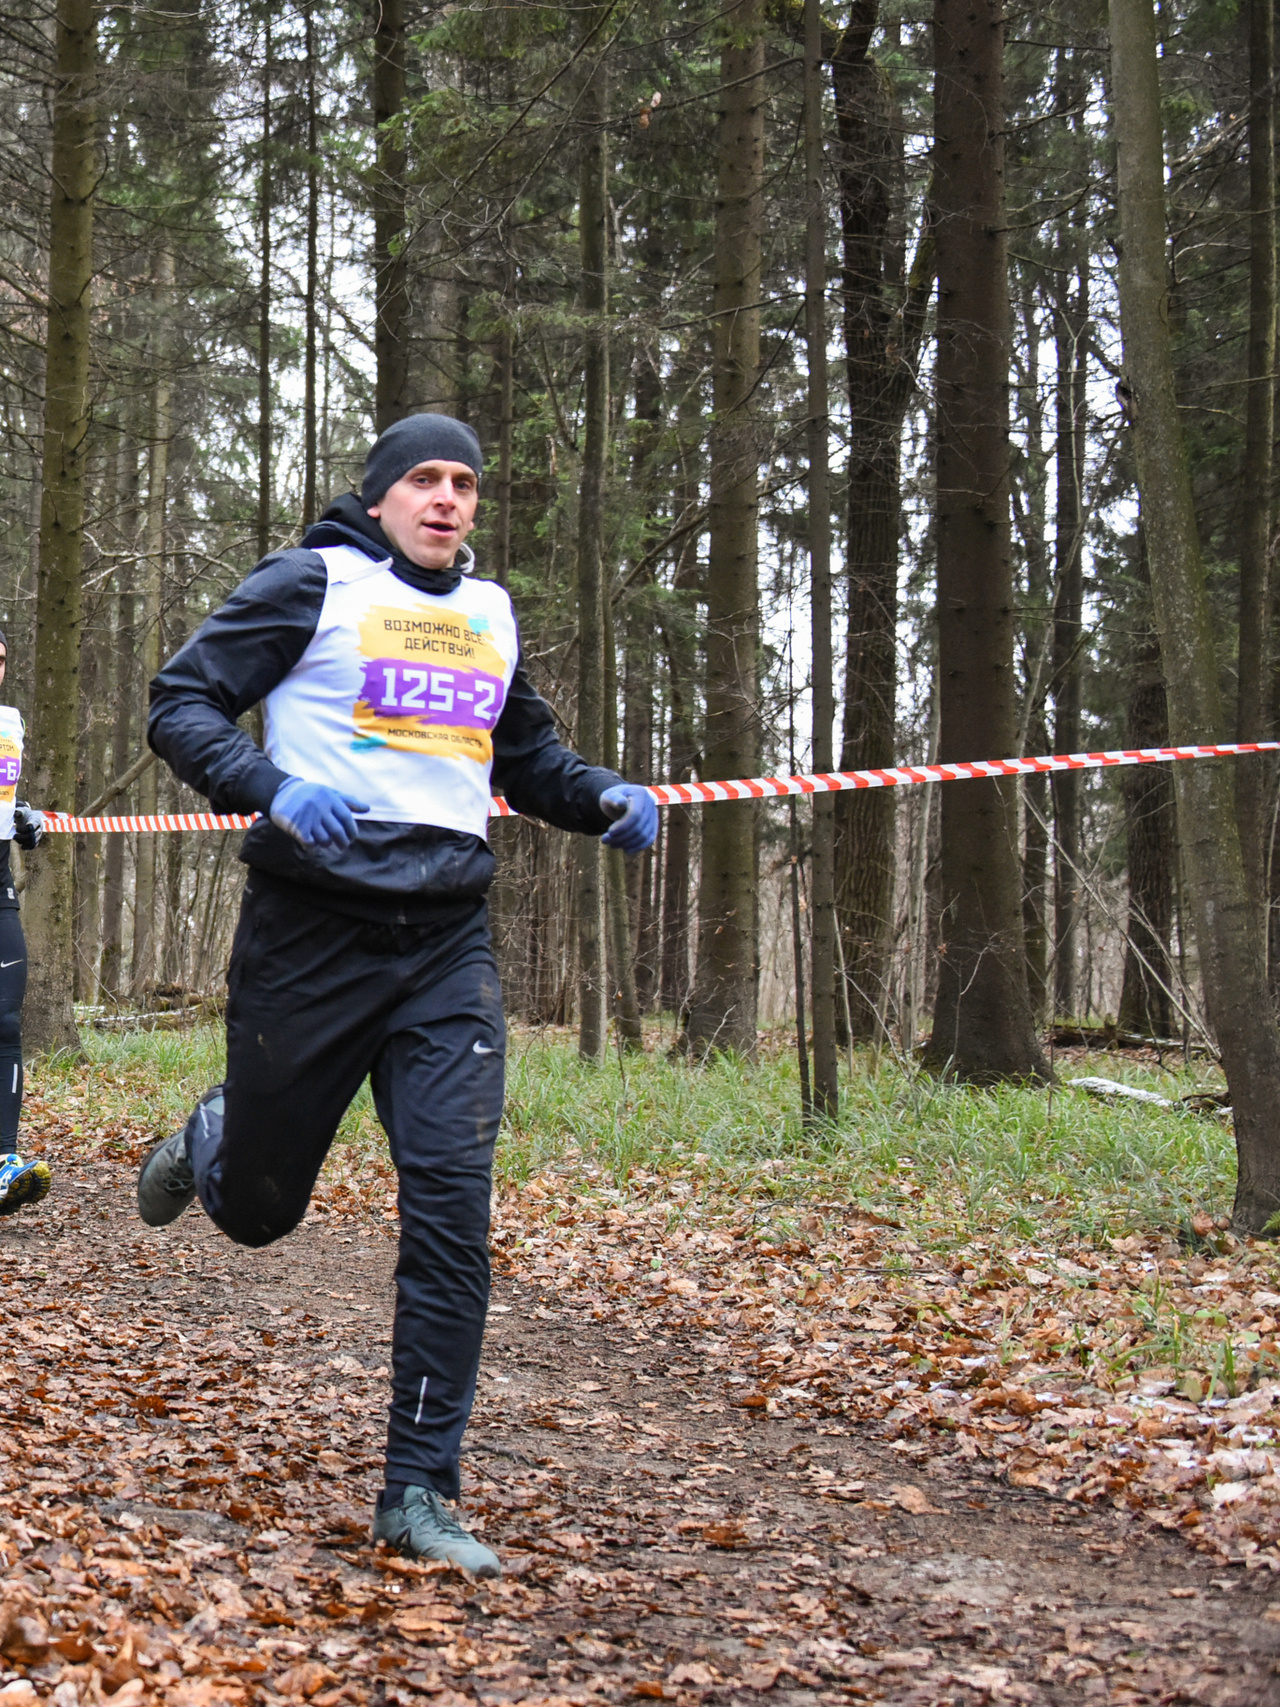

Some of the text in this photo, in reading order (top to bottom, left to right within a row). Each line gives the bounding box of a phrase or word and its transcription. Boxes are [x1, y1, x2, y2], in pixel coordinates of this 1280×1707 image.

[383, 619, 460, 639] ВОЗМОЖНО
[404, 636, 476, 659] ДЕЙСТВУЙ!
[381, 667, 496, 721] 125-2
[387, 728, 449, 741] МОСКОВСКАЯ
